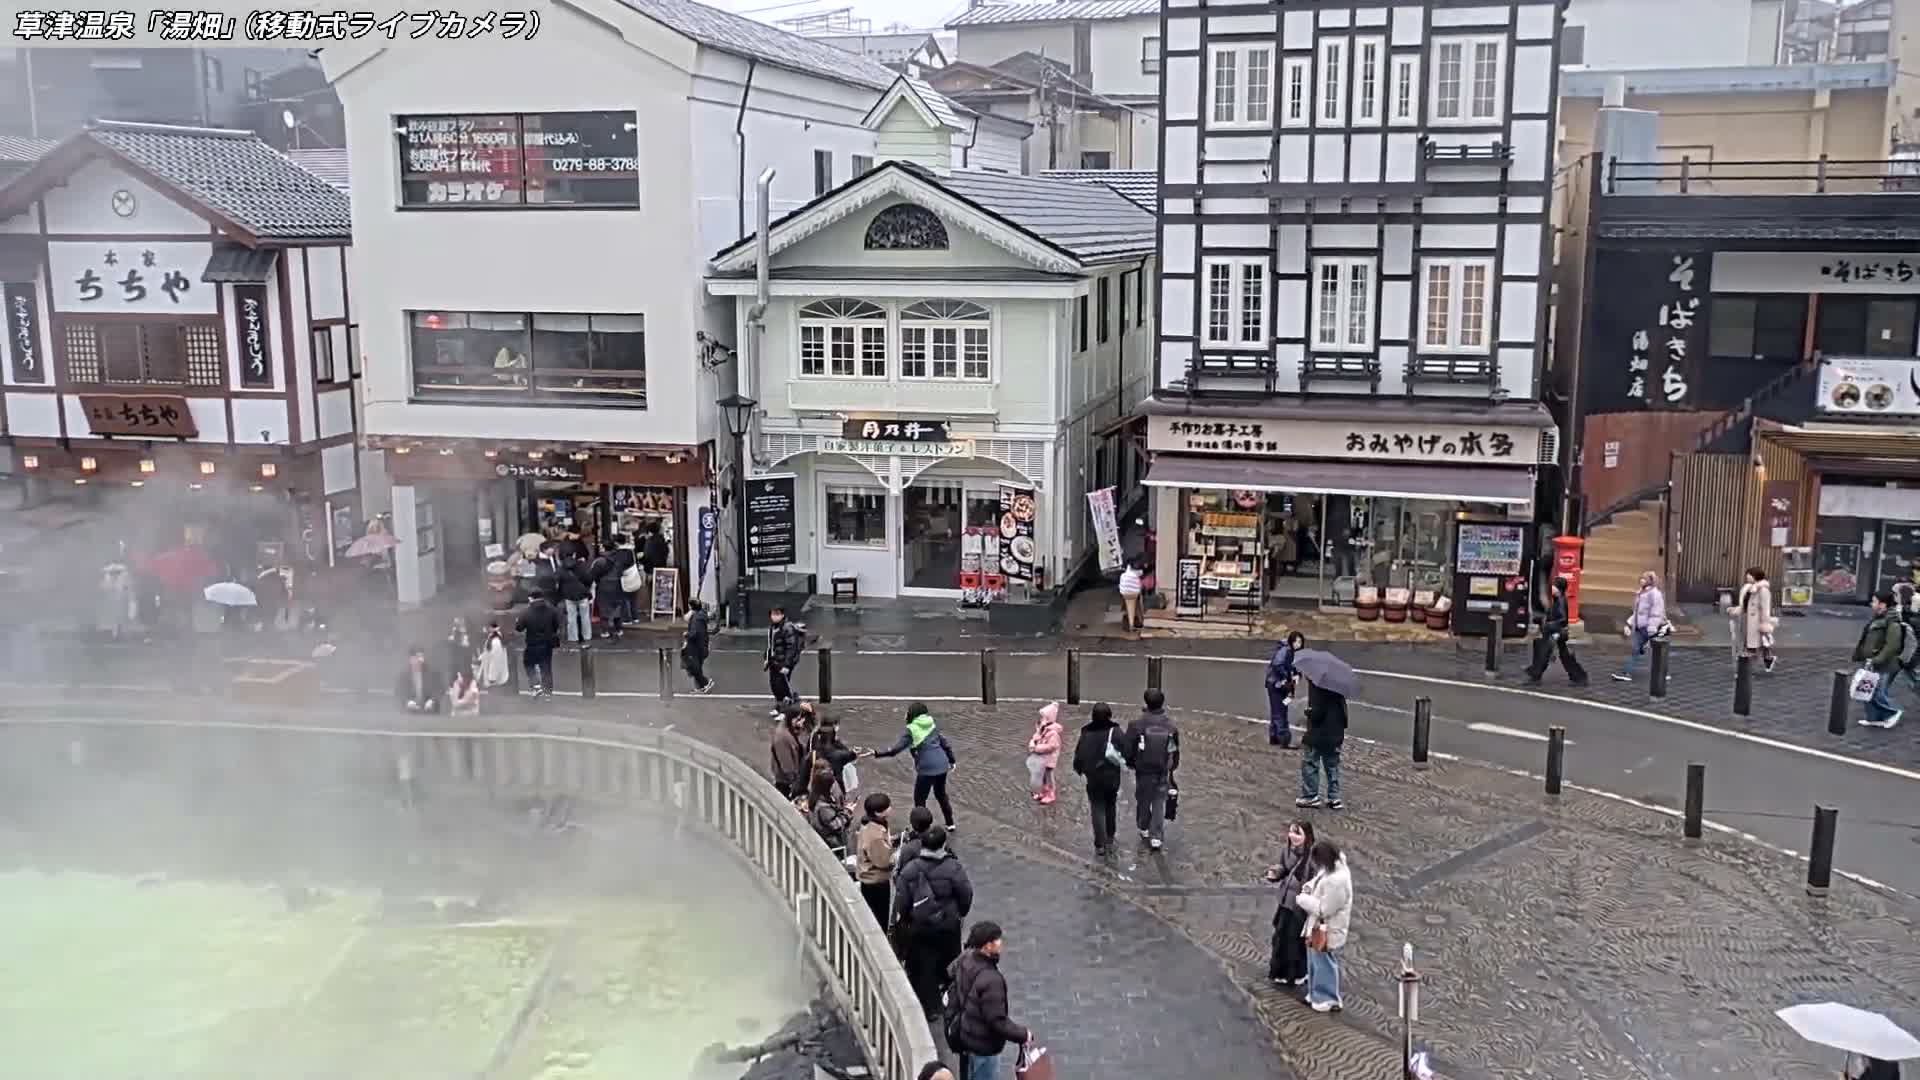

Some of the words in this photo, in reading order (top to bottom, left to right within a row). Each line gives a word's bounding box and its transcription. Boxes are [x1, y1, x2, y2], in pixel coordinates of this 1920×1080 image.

[427, 181, 504, 202] カラオケ
[75, 269, 190, 304] ちちや
[1658, 256, 1700, 402] そばきち
[117, 401, 178, 427] ちちや
[1169, 422, 1263, 438] 手作りお菓子工房
[1346, 431, 1514, 456] おみやげの本多
